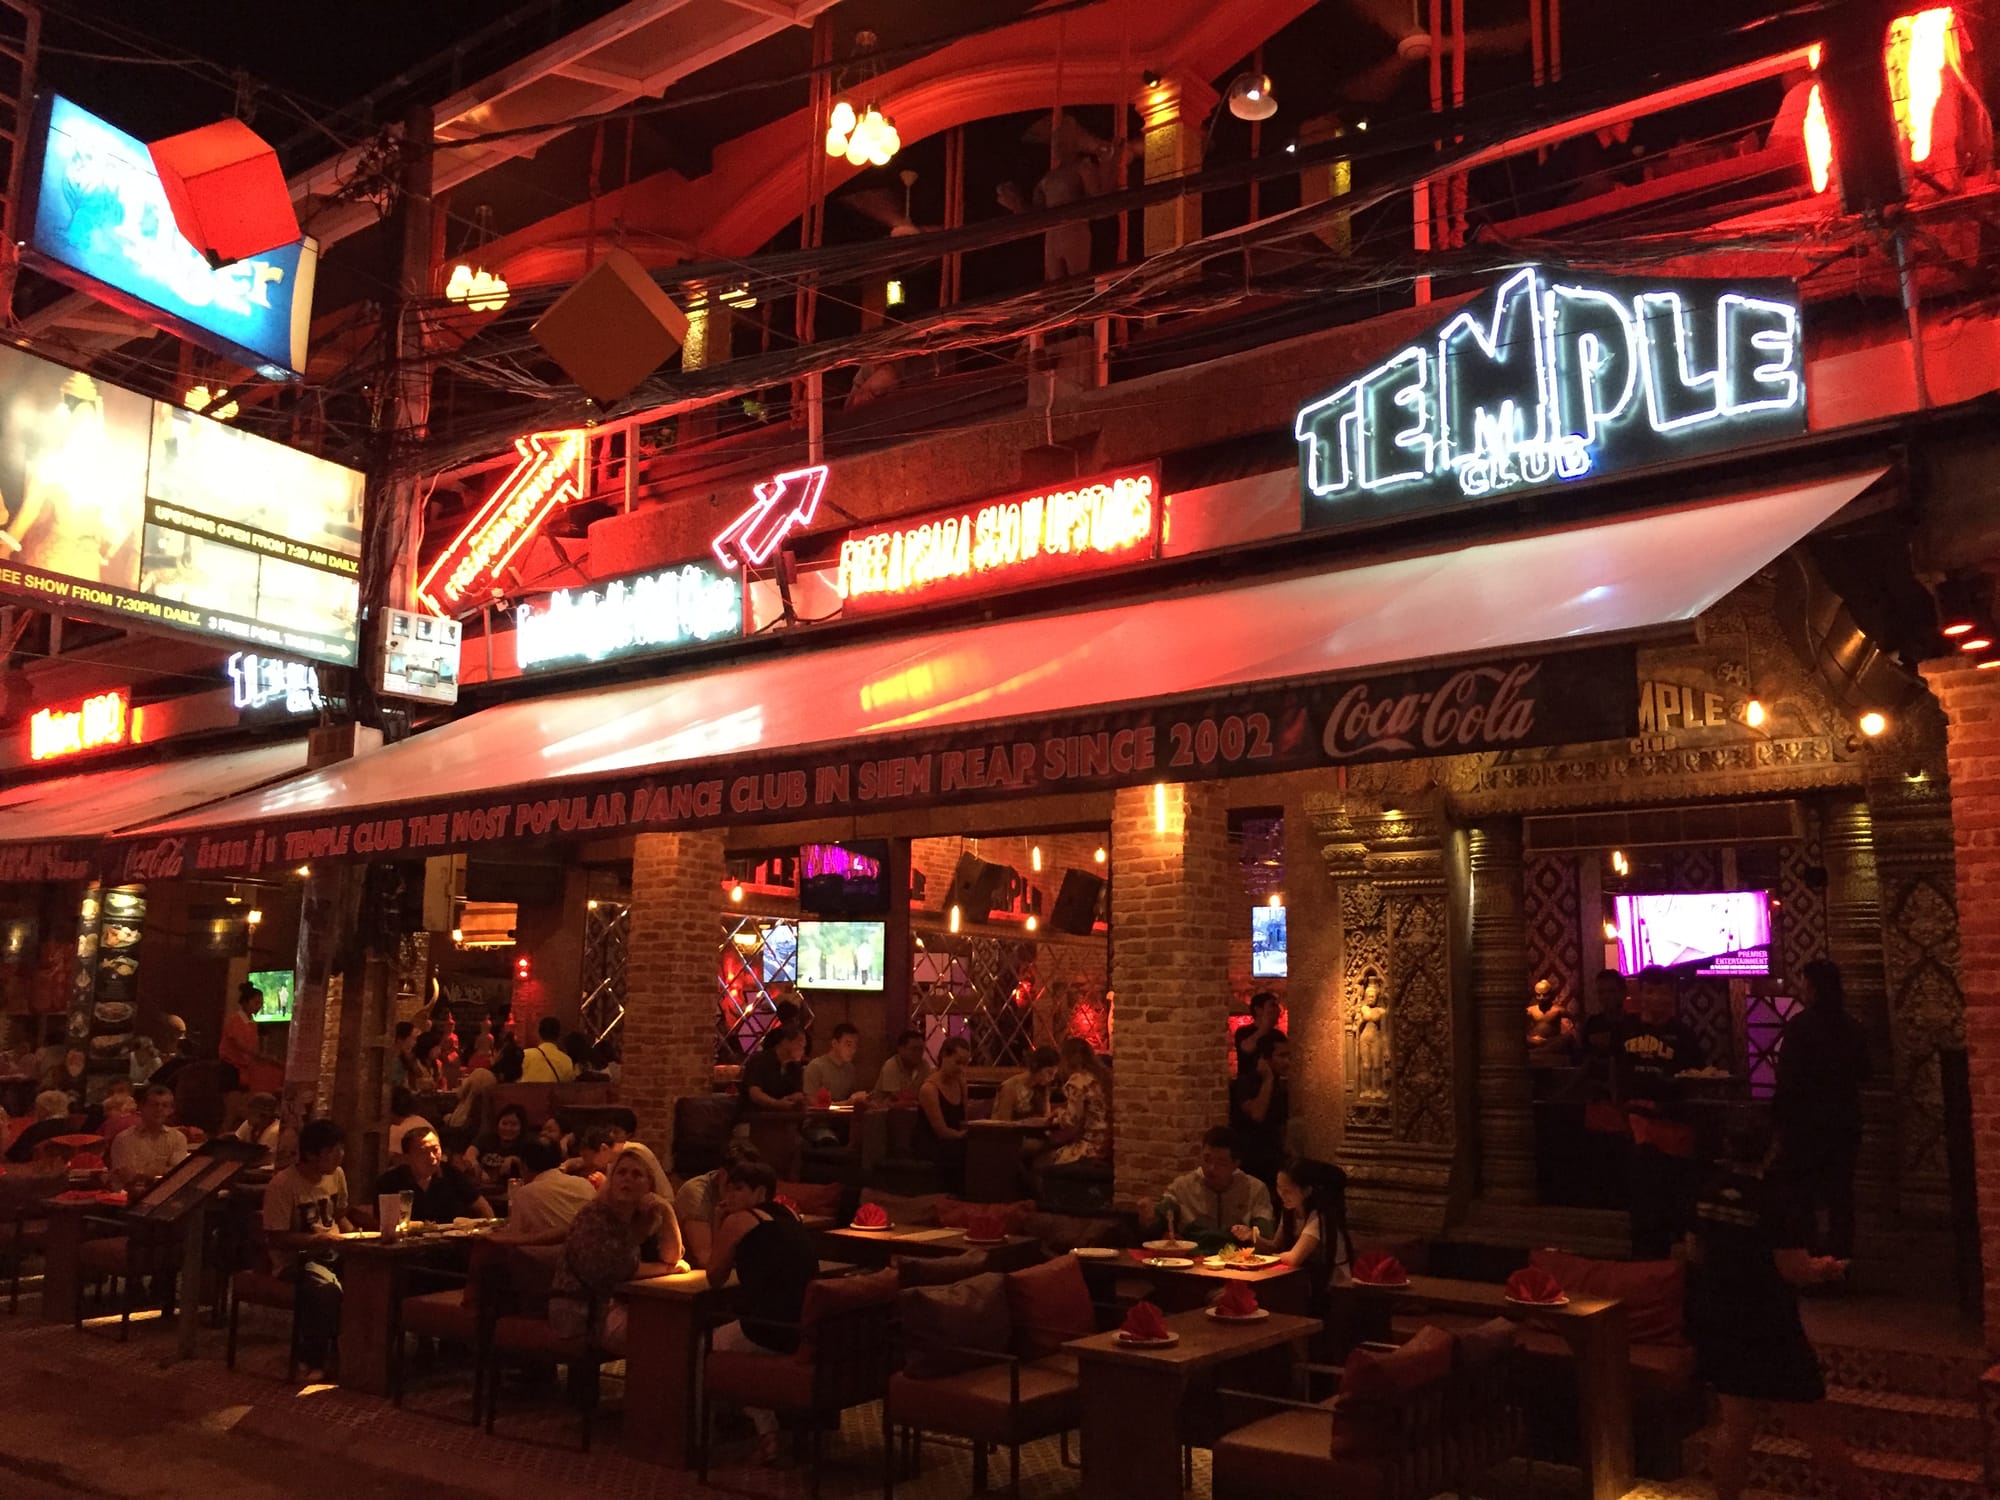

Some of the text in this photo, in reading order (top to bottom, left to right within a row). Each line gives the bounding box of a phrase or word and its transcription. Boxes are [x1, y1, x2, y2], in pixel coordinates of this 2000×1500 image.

[1295, 266, 1799, 495] TEMPLE
[1459, 435, 1592, 496] CLUB
[154, 504, 216, 534] UPSTAIRS
[217, 523, 251, 545] OPEN
[252, 533, 286, 555] FROM
[309, 550, 328, 566] AM
[838, 532, 890, 599] FREE
[974, 496, 1045, 571] SHOW
[1045, 475, 1152, 553] UPSTAIRS
[24, 573, 70, 597] SHOW
[72, 585, 114, 607] FROM
[116, 595, 161, 617] 7:30PM
[208, 616, 218, 630] 3
[1322, 660, 1545, 758] Coca-Cola
[285, 825, 351, 860] TEMPLE
[353, 818, 404, 853] CLUB
[408, 811, 448, 847] THE
[451, 805, 512, 843] MOST
[515, 791, 626, 836] POPULAR
[631, 777, 724, 823] DANCE
[730, 770, 808, 814] CLUB
[815, 764, 850, 804] IN
[858, 752, 932, 800] SIEM
[941, 742, 1037, 792] REAP
[1043, 727, 1156, 780] SINCE
[1170, 712, 1273, 767] 2002
[1715, 957, 1769, 965] ENTERTAINMENT
[1737, 950, 1768, 958] PREMIER
